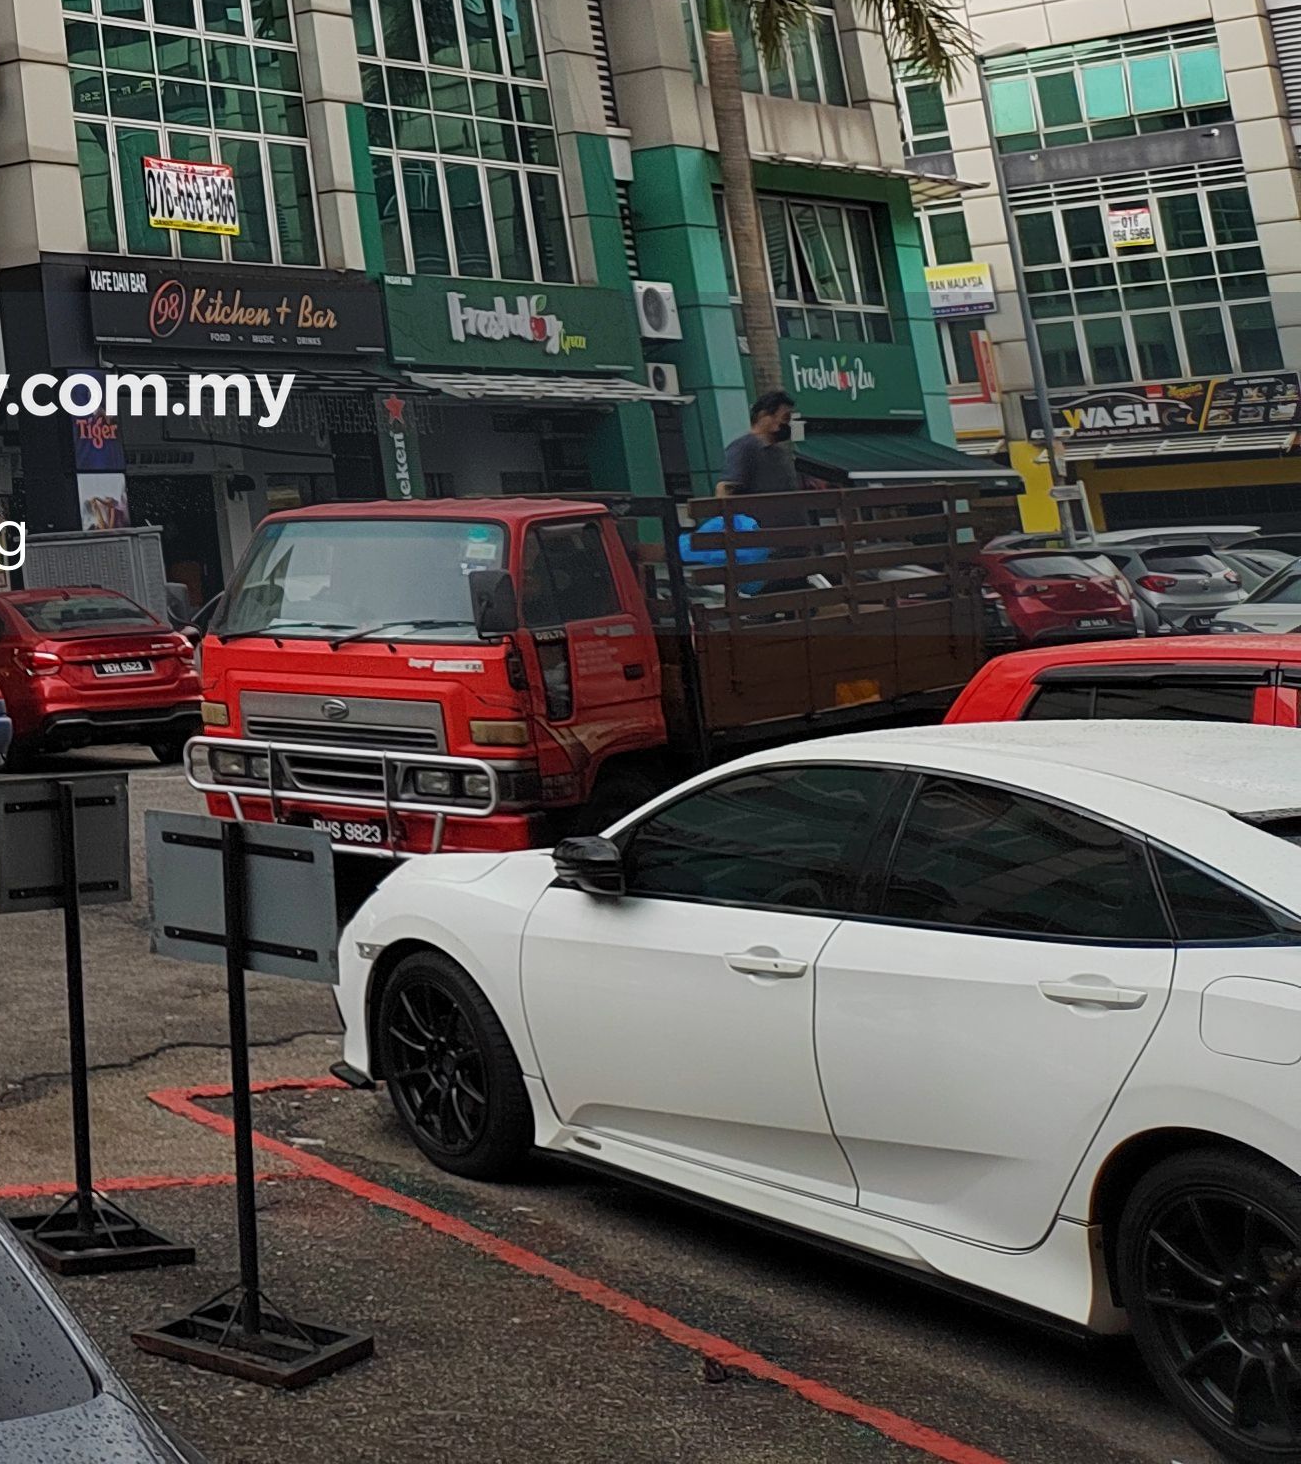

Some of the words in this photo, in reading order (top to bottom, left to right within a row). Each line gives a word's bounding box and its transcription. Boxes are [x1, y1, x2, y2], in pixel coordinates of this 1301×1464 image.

[90, 270, 111, 291] KAFE
[113, 272, 129, 292] DAN
[131, 273, 147, 293] BAR
[156, 293, 179, 325] 98
[189, 288, 271, 327] Kitchen
[297, 294, 337, 329] Bar
[210, 333, 231, 342] FOOD
[252, 334, 275, 344] MUSIC
[296, 336, 322, 346] DRINKS
[1061, 402, 1160, 429] WASH
[76, 417, 117, 449] Tiger
[344, 822, 382, 843] 9823
